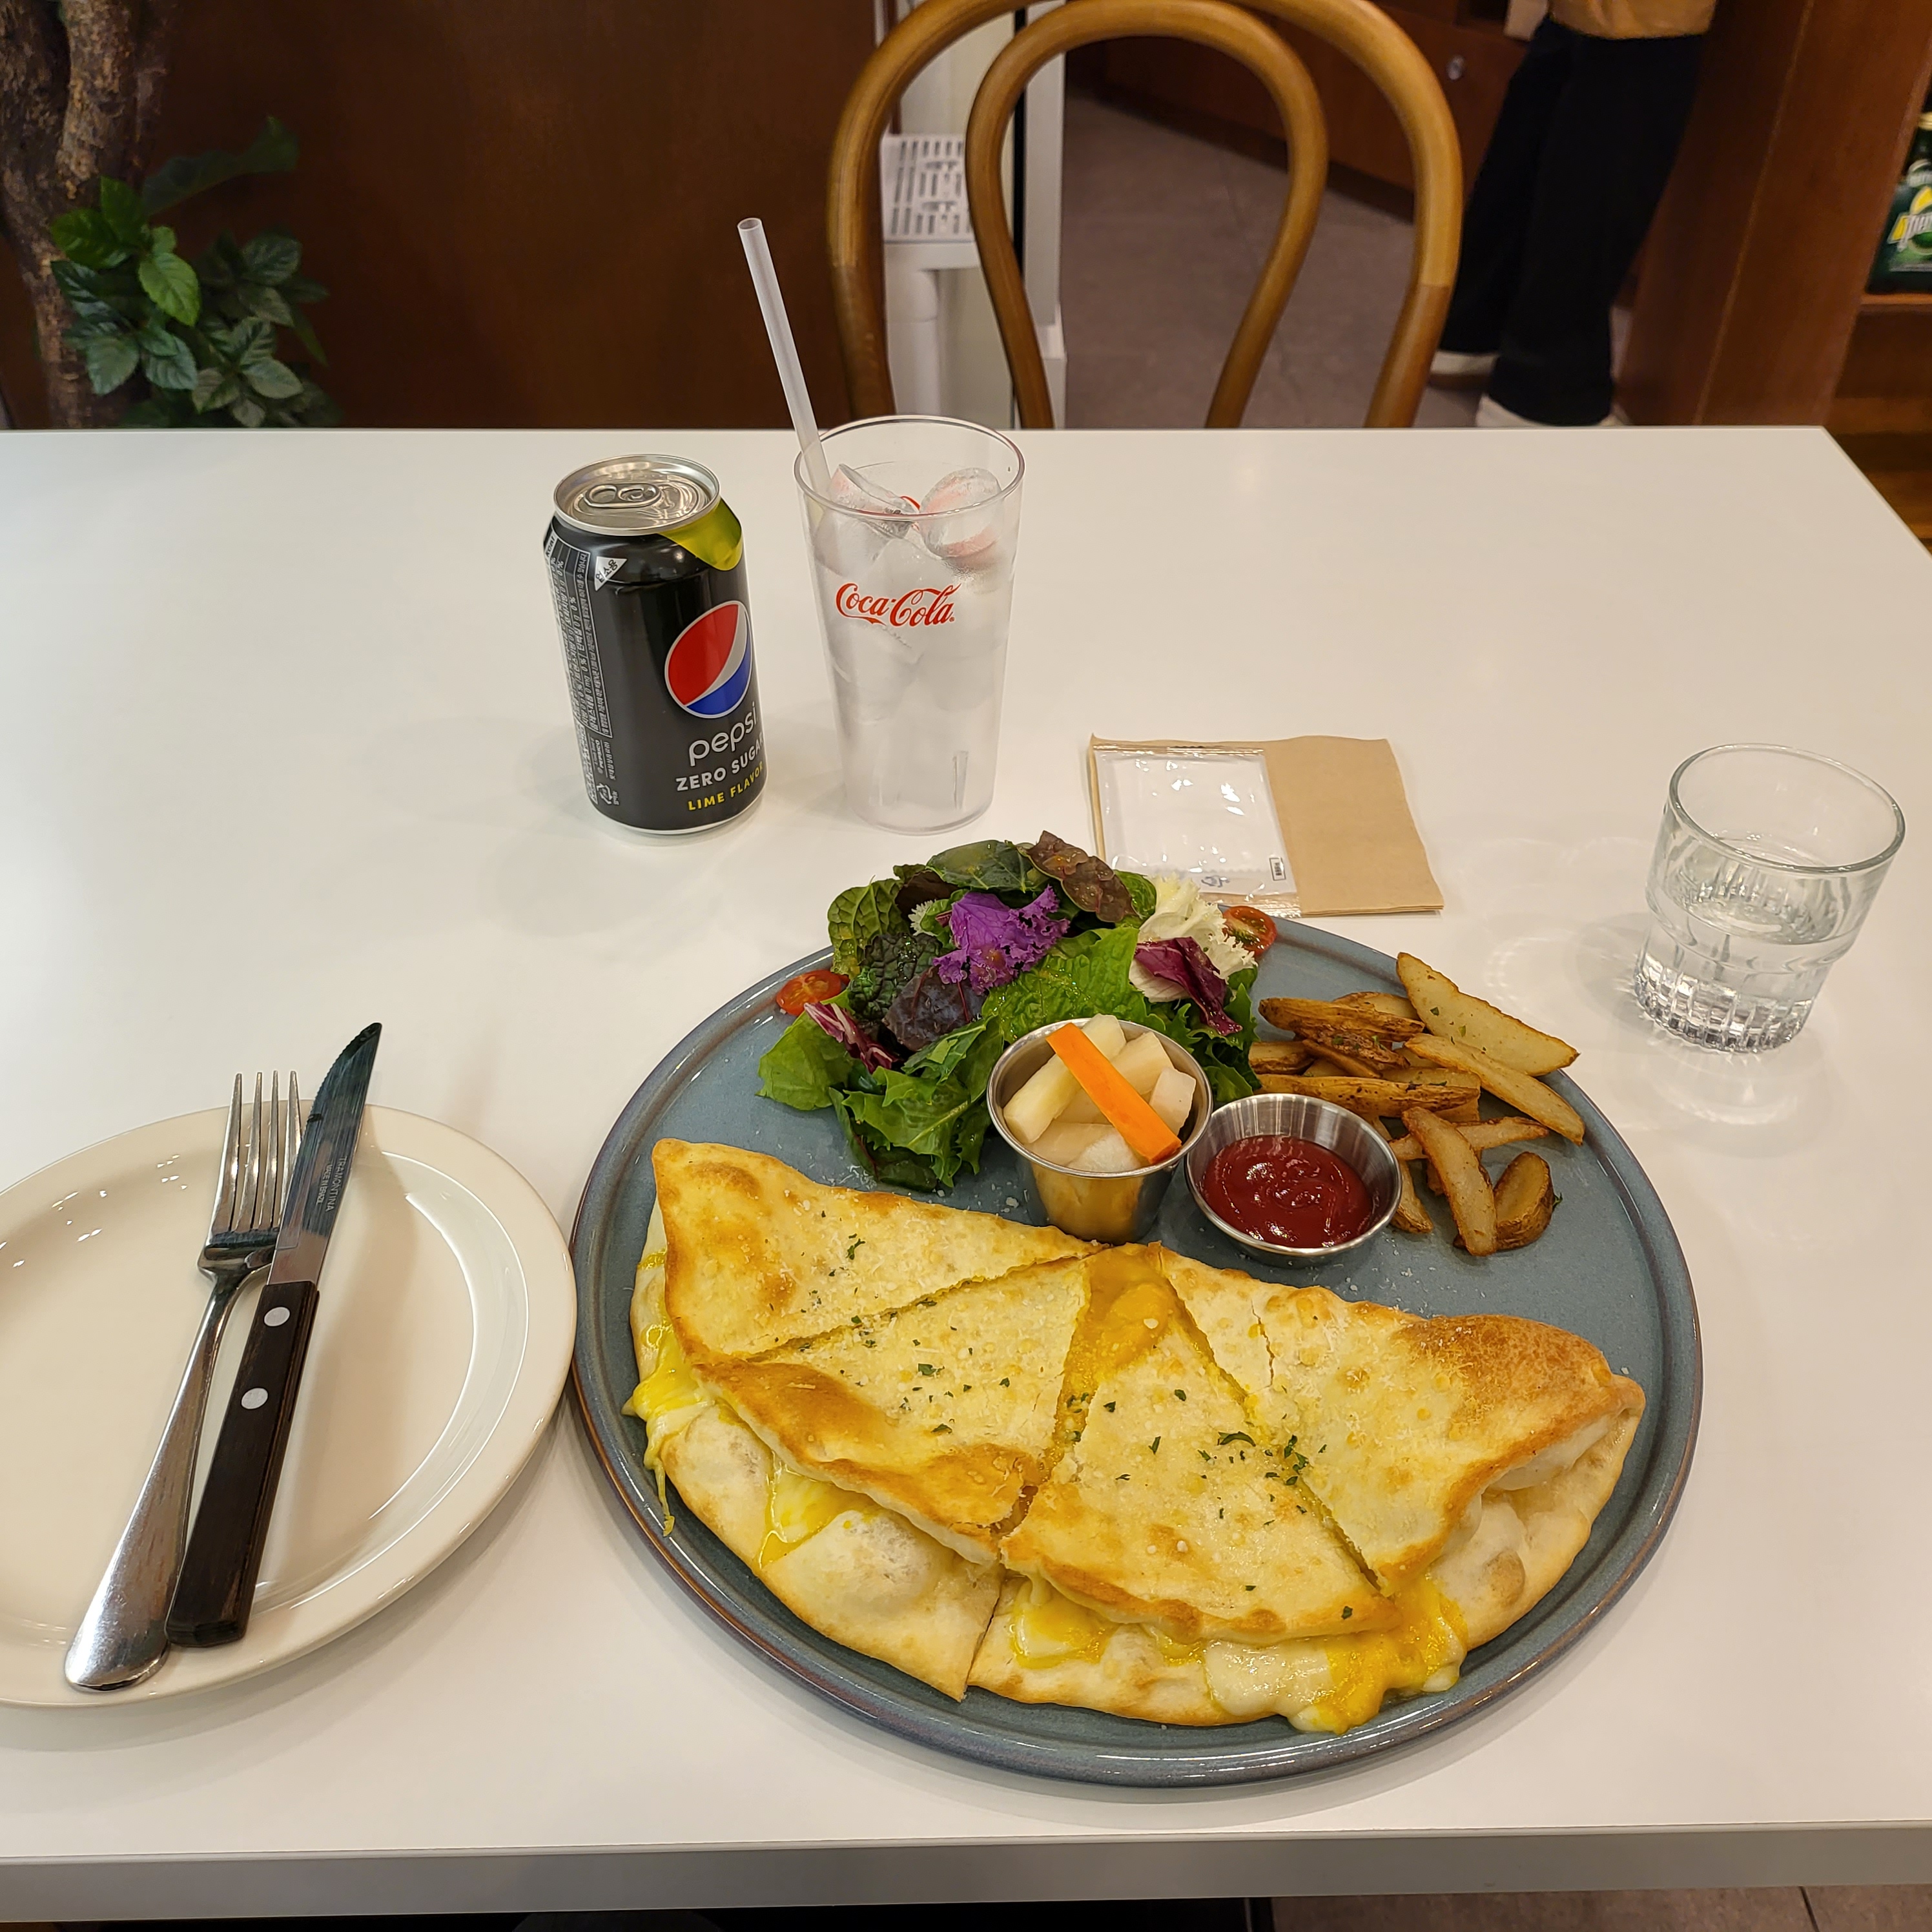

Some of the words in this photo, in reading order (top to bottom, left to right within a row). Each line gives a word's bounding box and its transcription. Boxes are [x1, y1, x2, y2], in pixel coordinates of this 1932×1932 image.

[546, 535, 555, 557] kcal
[596, 559, 618, 582] 업소용
[688, 701, 757, 766] pepsi
[595, 740, 604, 768] PEPSICO
[675, 767, 726, 792] ZERO
[688, 792, 724, 811] LIME
[323, 1163, 333, 1180] MADE
[325, 1156, 348, 1211] TRAMONTINA
[316, 1186, 328, 1205] BRAZIL
